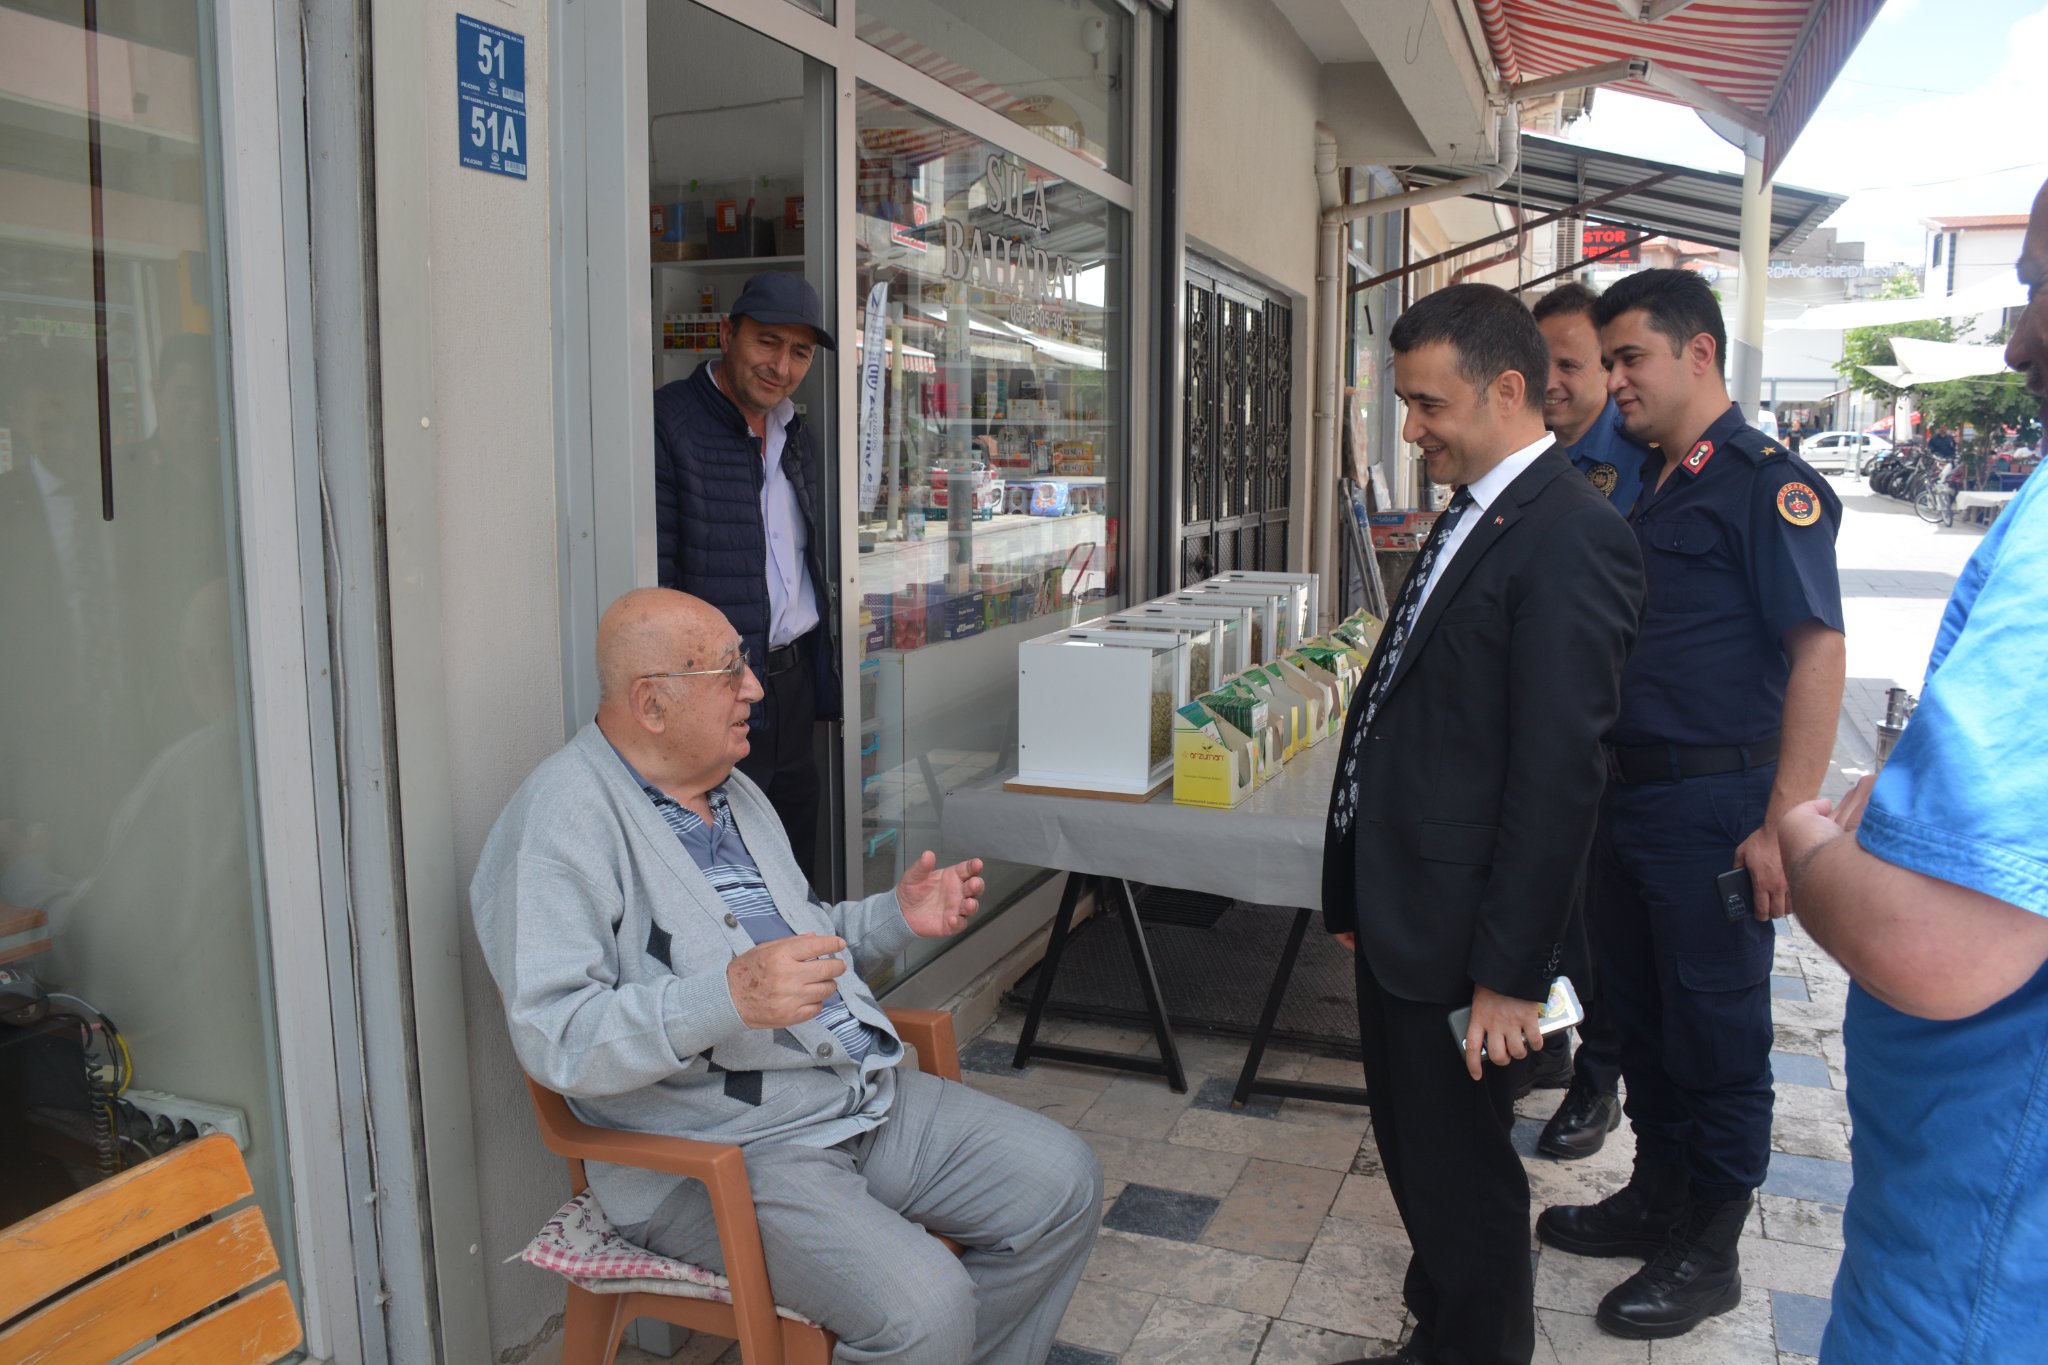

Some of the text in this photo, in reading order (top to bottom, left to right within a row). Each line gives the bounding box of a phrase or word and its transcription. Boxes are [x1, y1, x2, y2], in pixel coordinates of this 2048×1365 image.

[478, 33, 505, 80] 51
[471, 106, 520, 157] 51A
[986, 153, 1051, 232] SILA
[1583, 230, 1627, 243] STOR
[943, 216, 1083, 309] BAHARAT
[1766, 262, 1809, 279] RDAĞ
